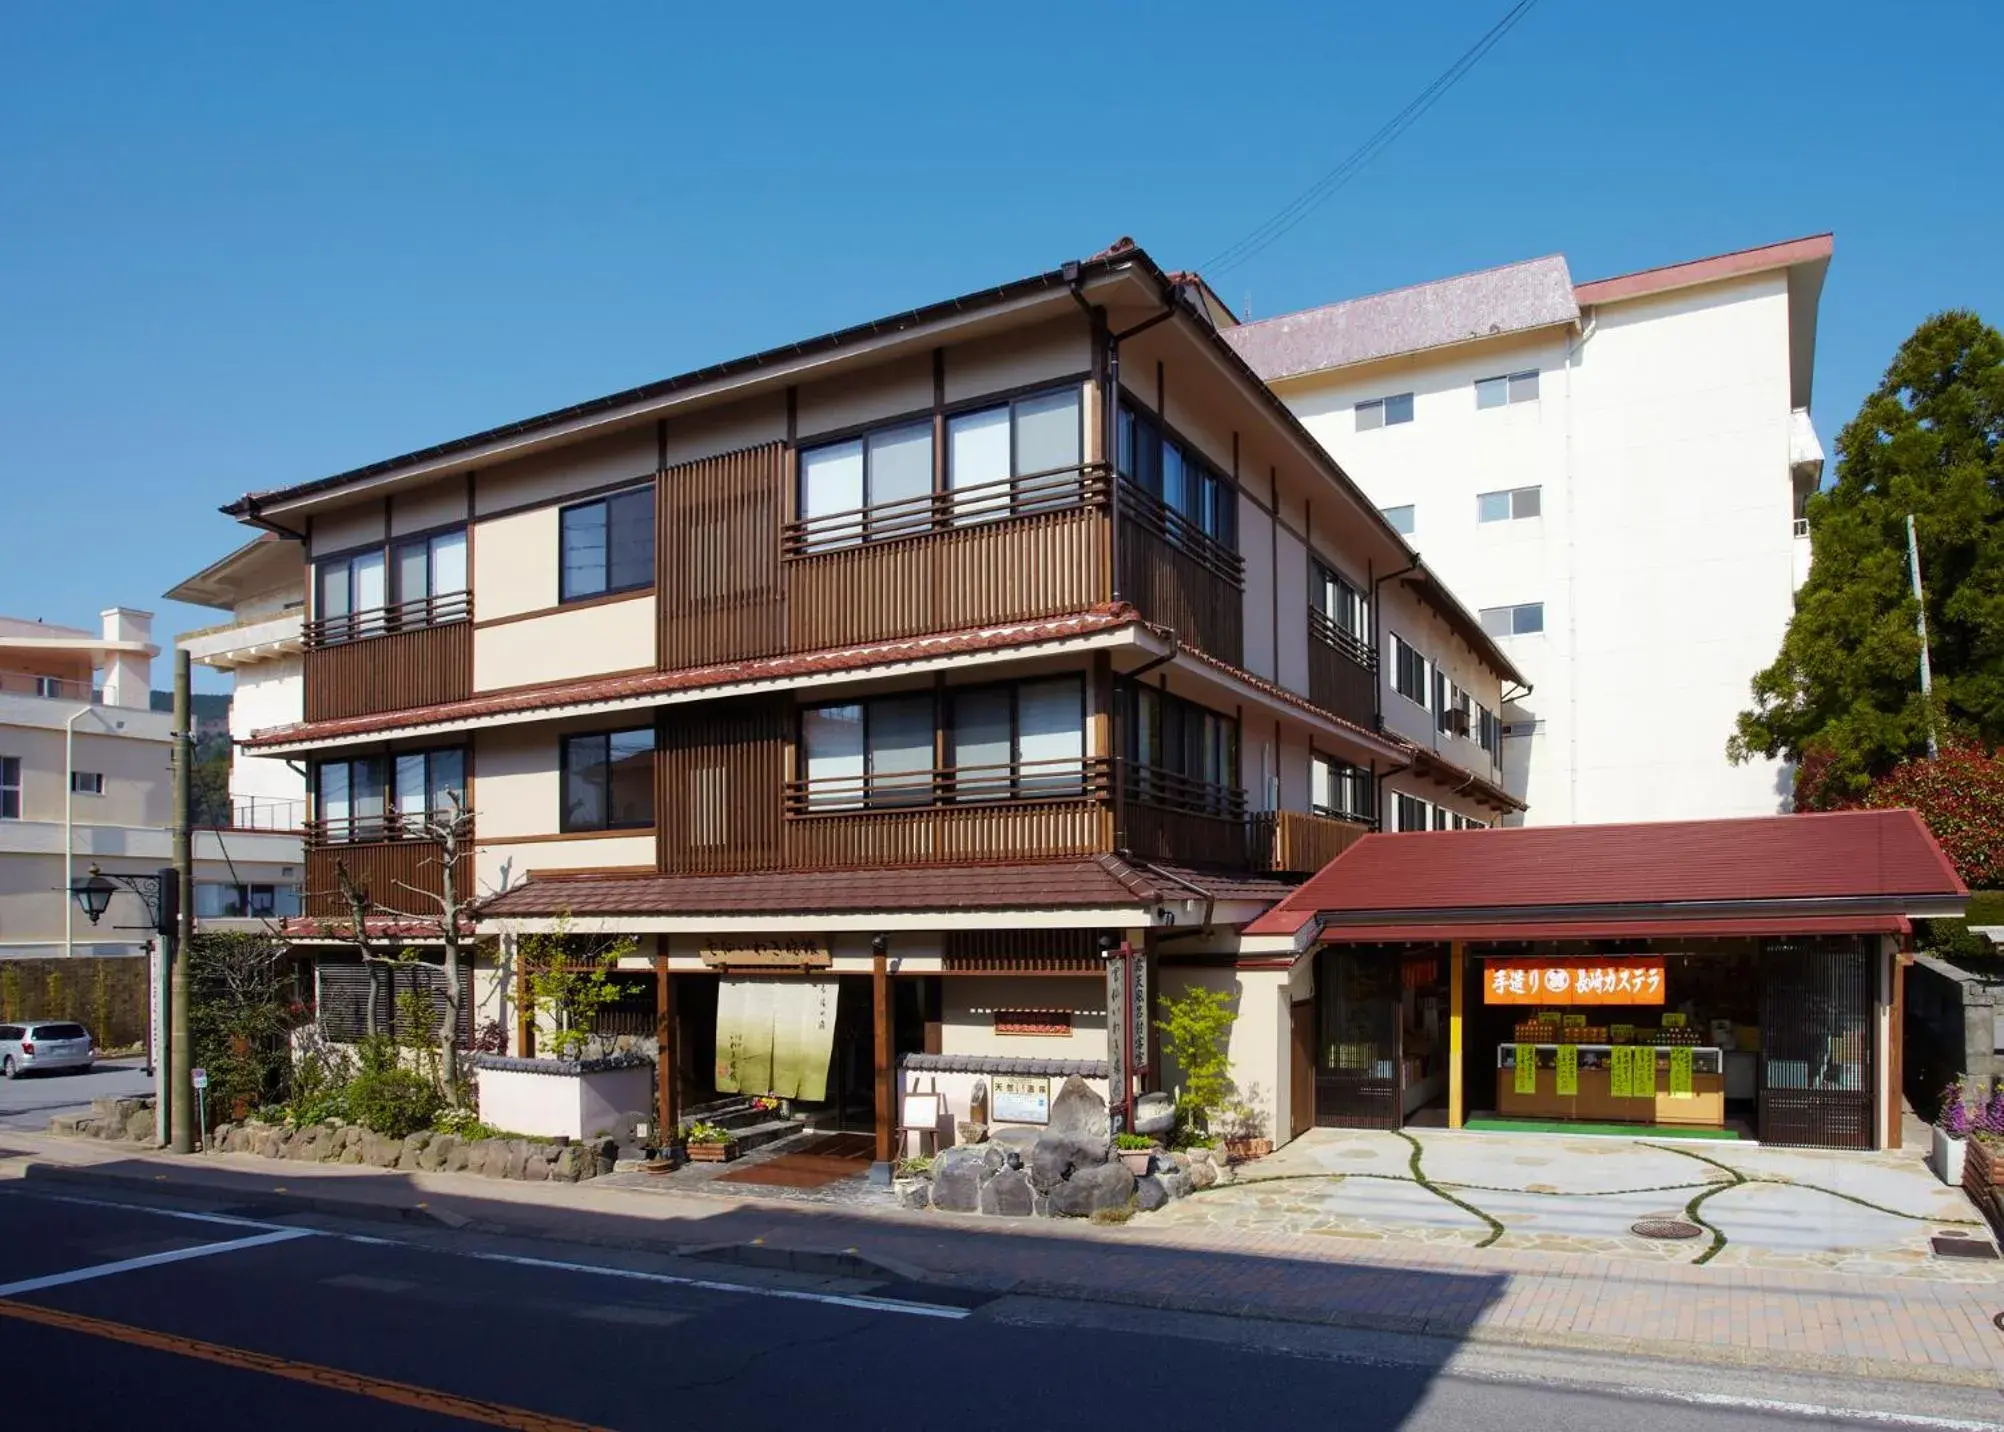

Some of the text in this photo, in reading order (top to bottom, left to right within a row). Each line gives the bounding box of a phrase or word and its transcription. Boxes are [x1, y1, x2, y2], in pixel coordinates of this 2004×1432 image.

[1492, 968, 1539, 994] 手造り
[1576, 967, 1660, 994] 長崎カステラ
